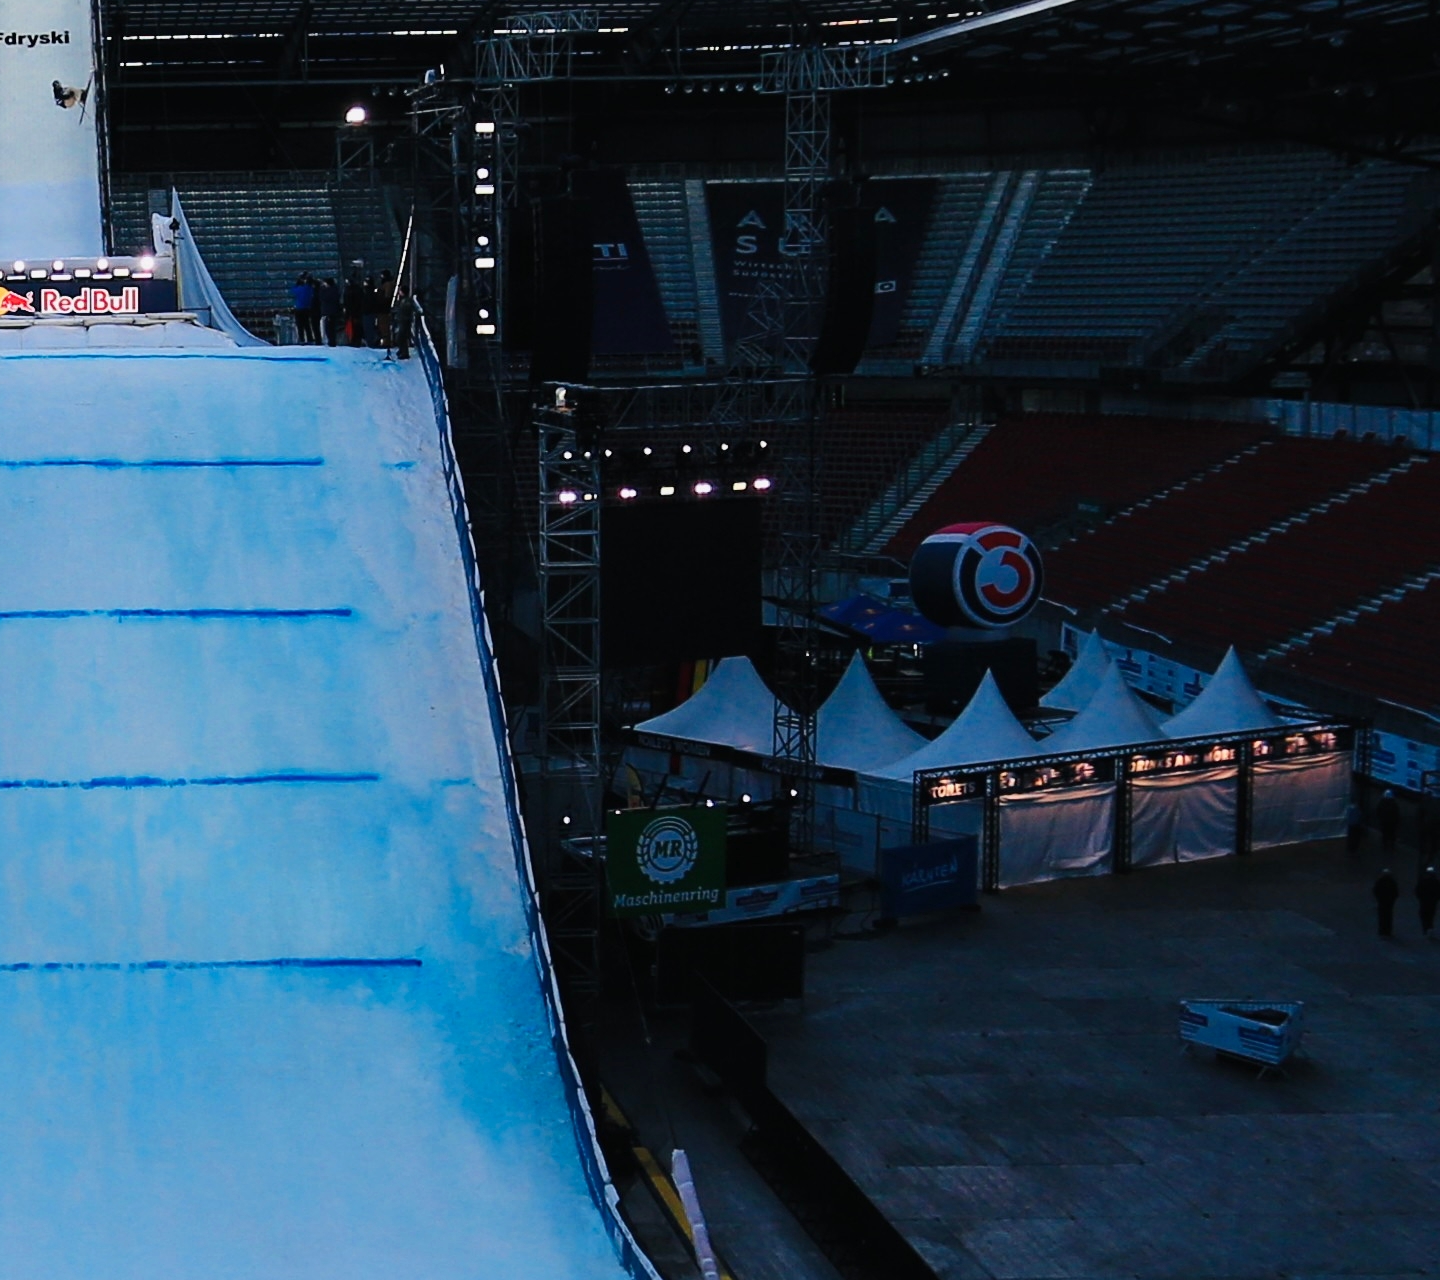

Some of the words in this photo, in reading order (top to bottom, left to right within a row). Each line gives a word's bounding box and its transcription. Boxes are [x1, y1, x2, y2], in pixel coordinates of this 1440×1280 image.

[929, 780, 977, 799] TOILETS
[653, 839, 683, 859] MR
[613, 886, 720, 909] Maschinenring
